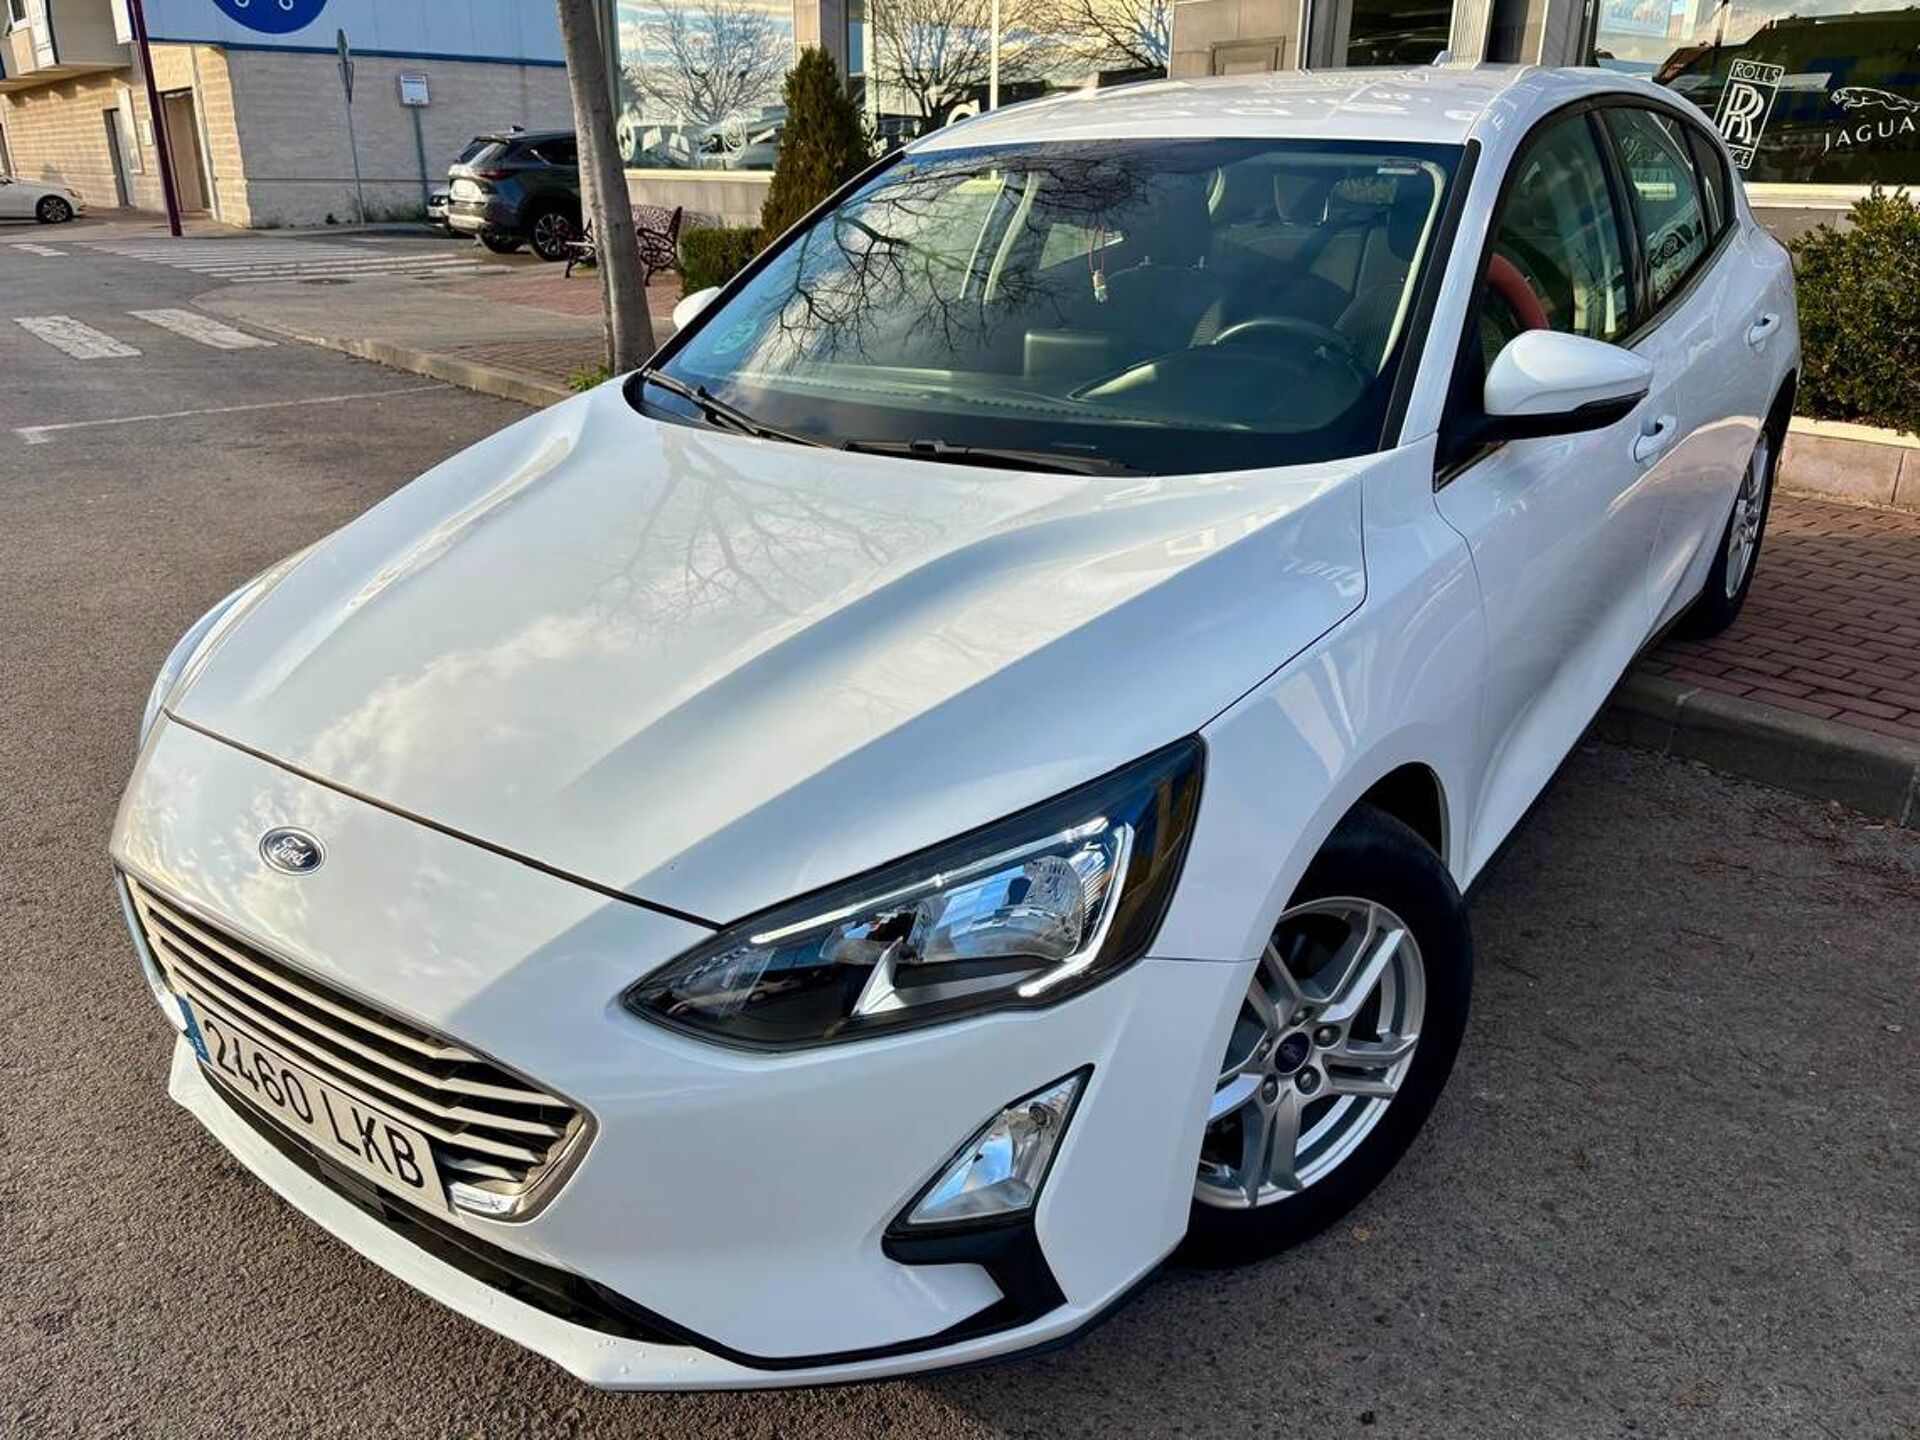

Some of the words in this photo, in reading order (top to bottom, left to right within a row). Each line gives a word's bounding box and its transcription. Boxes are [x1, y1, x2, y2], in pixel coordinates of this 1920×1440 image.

[1734, 63, 1779, 83] ROLLS
[1821, 115, 1916, 156] JAGUA
[271, 836, 311, 866] Ford
[204, 1019, 314, 1125] 2460
[320, 1088, 424, 1189] LKB
